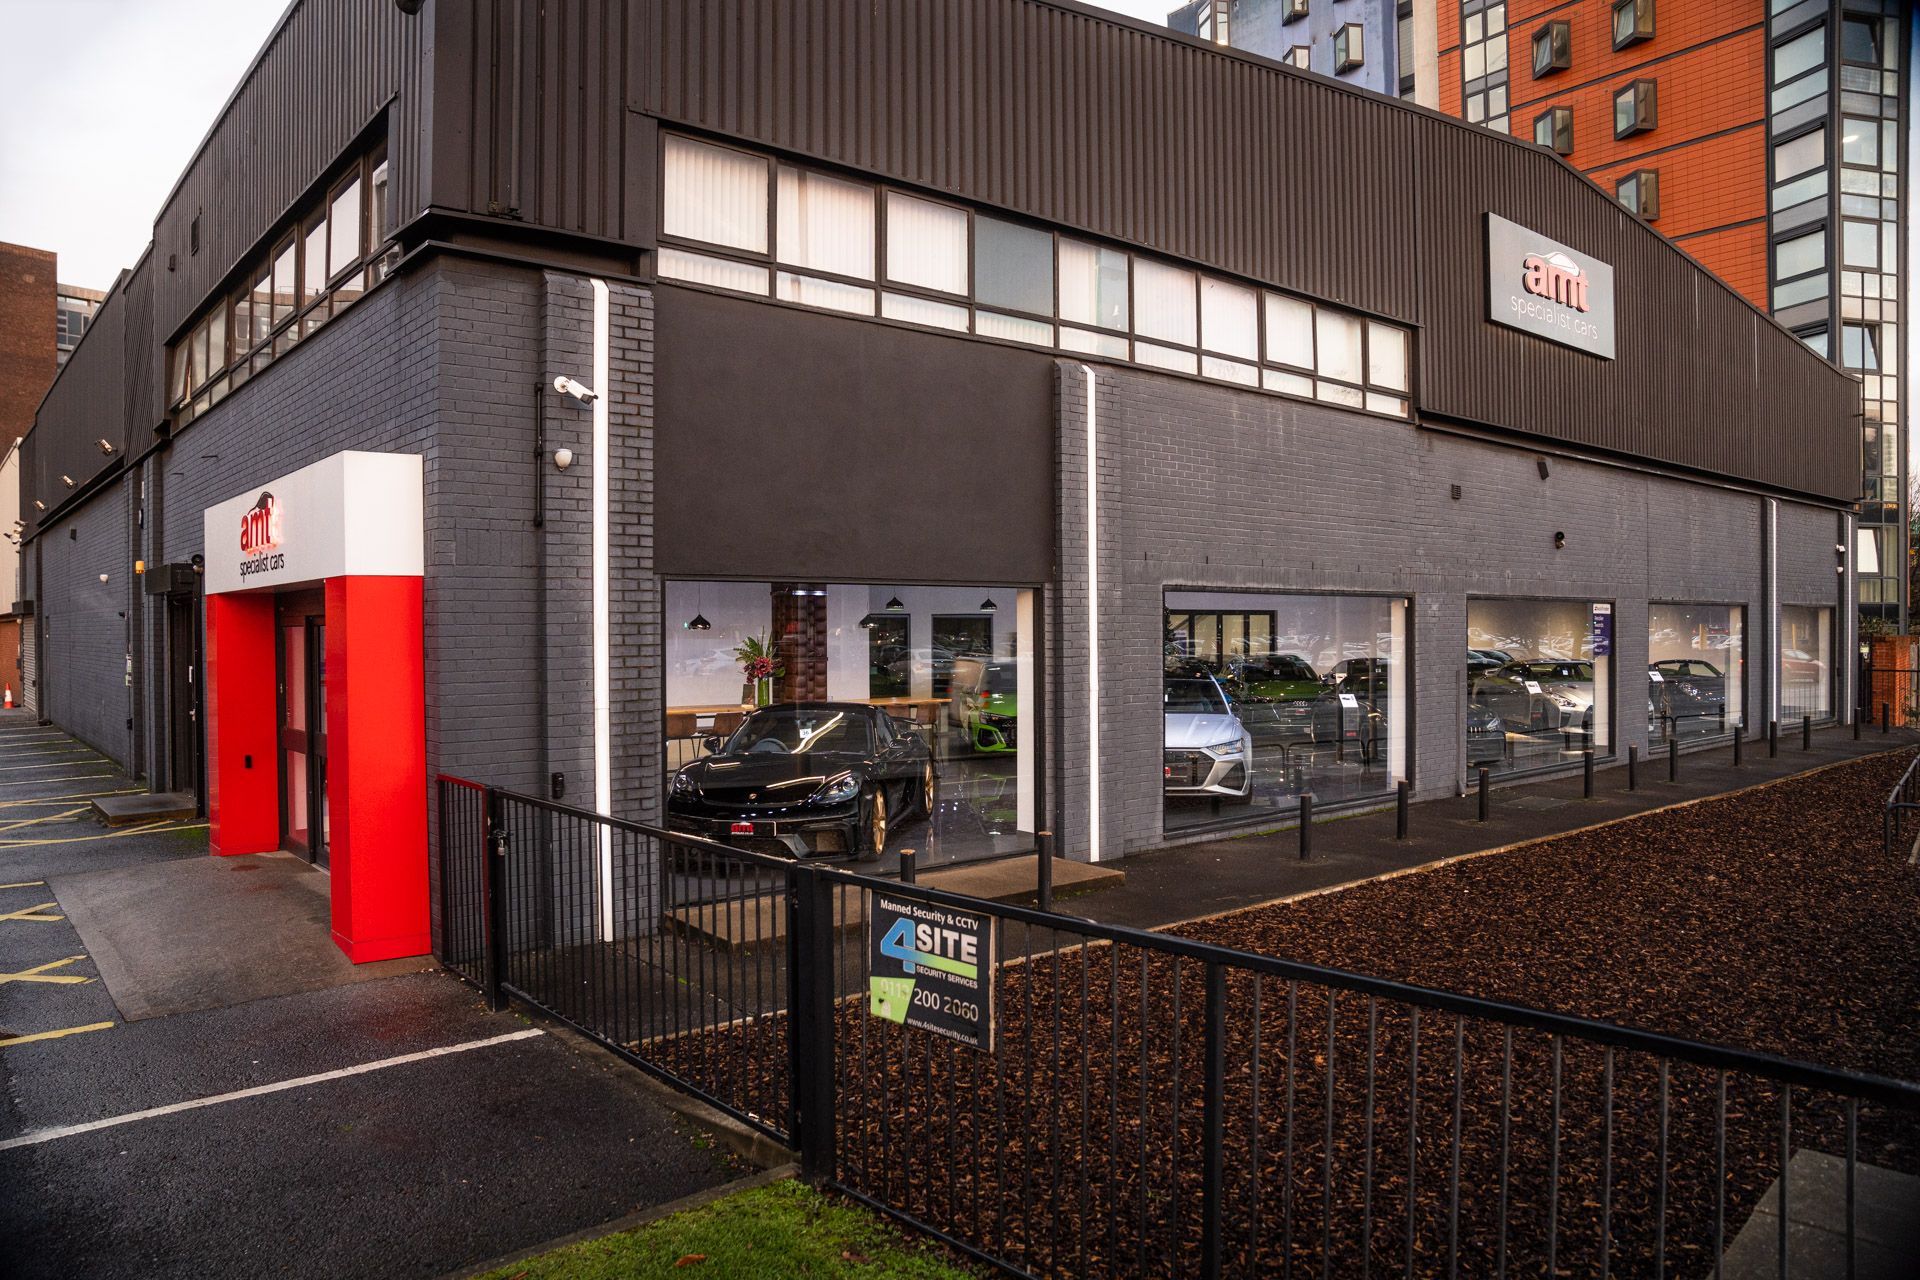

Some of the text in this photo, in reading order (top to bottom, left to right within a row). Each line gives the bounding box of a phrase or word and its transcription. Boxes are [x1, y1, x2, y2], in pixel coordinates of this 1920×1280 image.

[1522, 256, 1590, 313] amt
[1511, 295, 1598, 340] specialist cars
[240, 503, 272, 551] amt
[239, 550, 285, 583] specialist cars
[880, 899, 979, 931] Manned Security & CCTV
[916, 965, 978, 989] SECURITY SERVICES
[913, 988, 940, 1010] 200
[943, 996, 979, 1022] 2060
